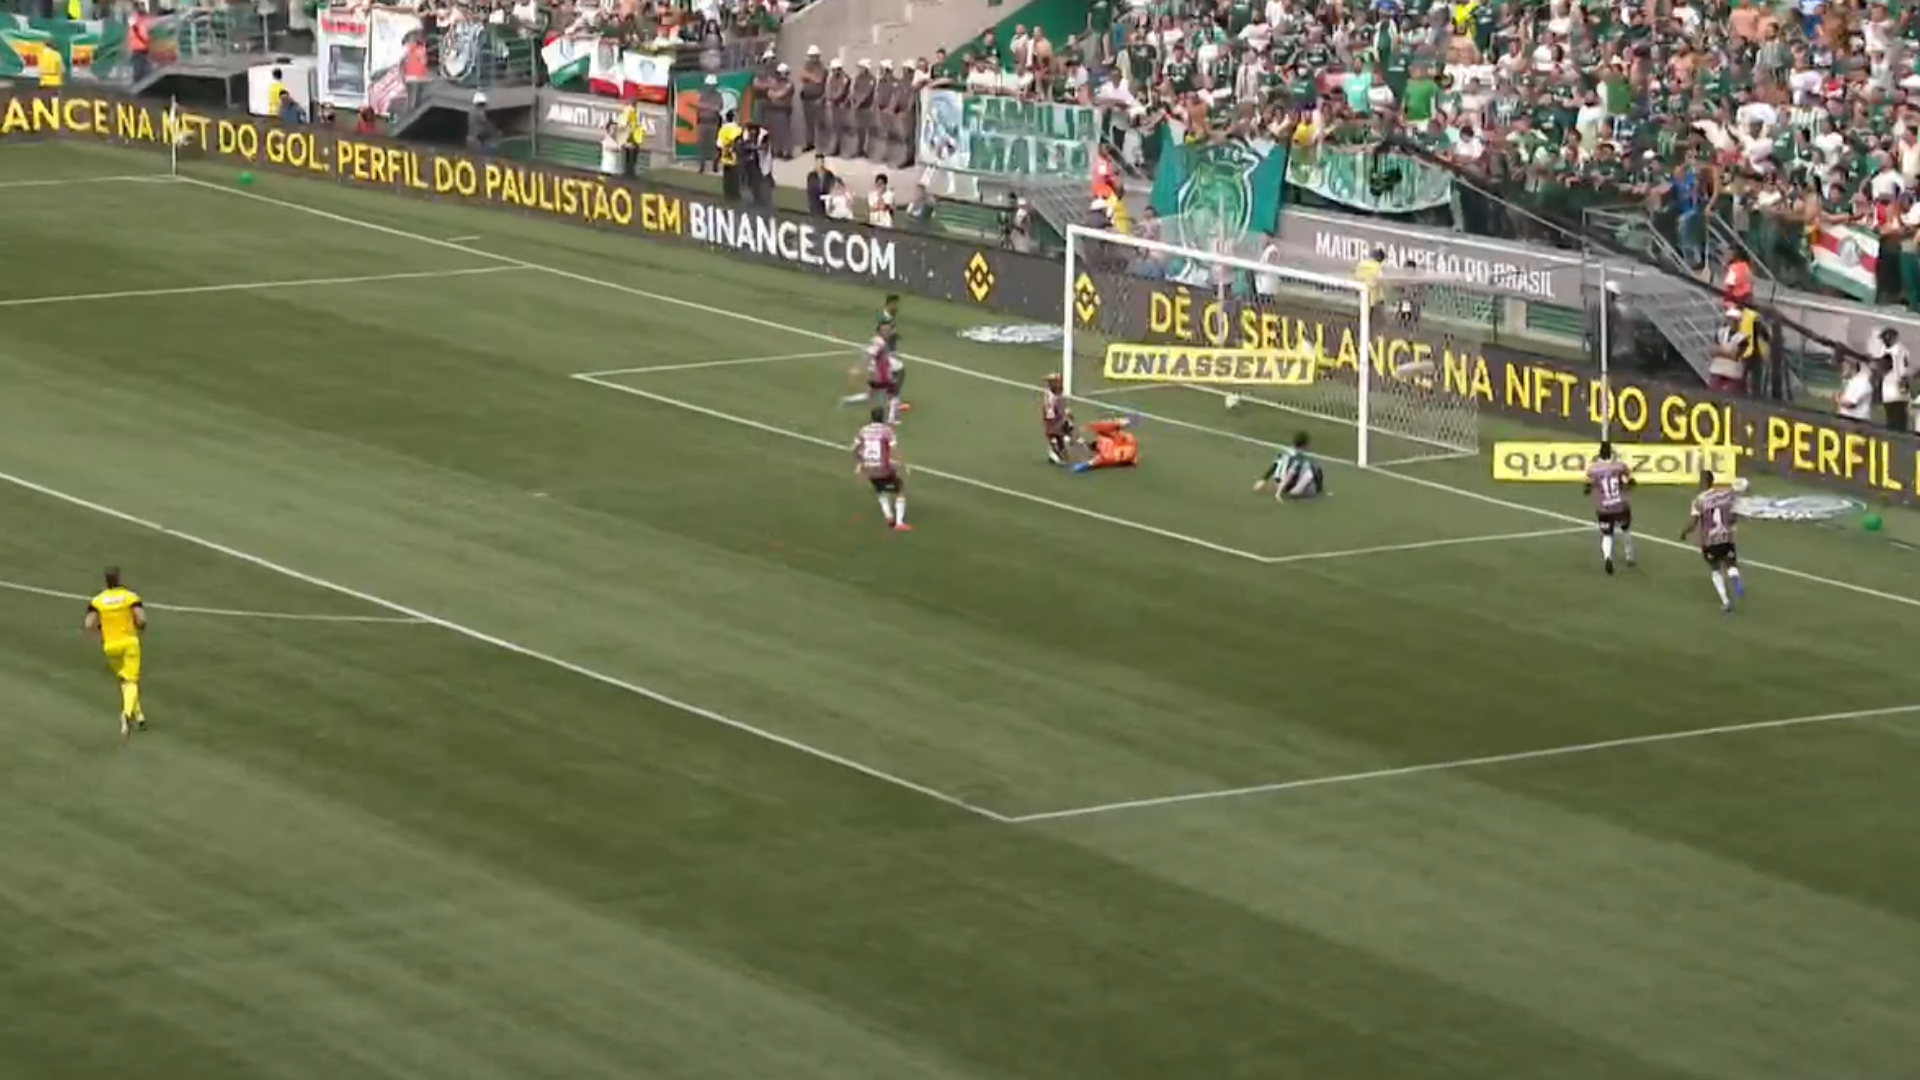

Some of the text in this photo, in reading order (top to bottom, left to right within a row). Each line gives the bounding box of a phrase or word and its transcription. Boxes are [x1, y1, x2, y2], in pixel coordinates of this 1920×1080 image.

[117, 102, 154, 141] NA
[162, 109, 212, 151] NFT
[218, 119, 258, 158] DO
[266, 128, 330, 172] GOL:
[337, 139, 428, 189] PERFIL
[433, 156, 477, 196] DO
[485, 163, 633, 225] PAULISTÃO
[640, 193, 682, 236] EM
[688, 201, 896, 280] BINANCE.COM
[1315, 231, 1370, 263] MAIOR
[1463, 254, 1490, 284] DO
[1493, 261, 1556, 298] BRASIL
[1111, 350, 1309, 380] UNIASSELVI
[1151, 286, 1194, 339] DÊ
[1203, 302, 1230, 346] O
[1240, 308, 1305, 355] SEU
[1315, 322, 1433, 389] LANCE
[1443, 350, 1494, 401] NA
[1506, 361, 1578, 417] NFT
[1589, 379, 1648, 431] DO
[1660, 394, 1753, 456] GOL:
[1767, 415, 1903, 491] PERFIL
[1504, 450, 1727, 477] quazolit
